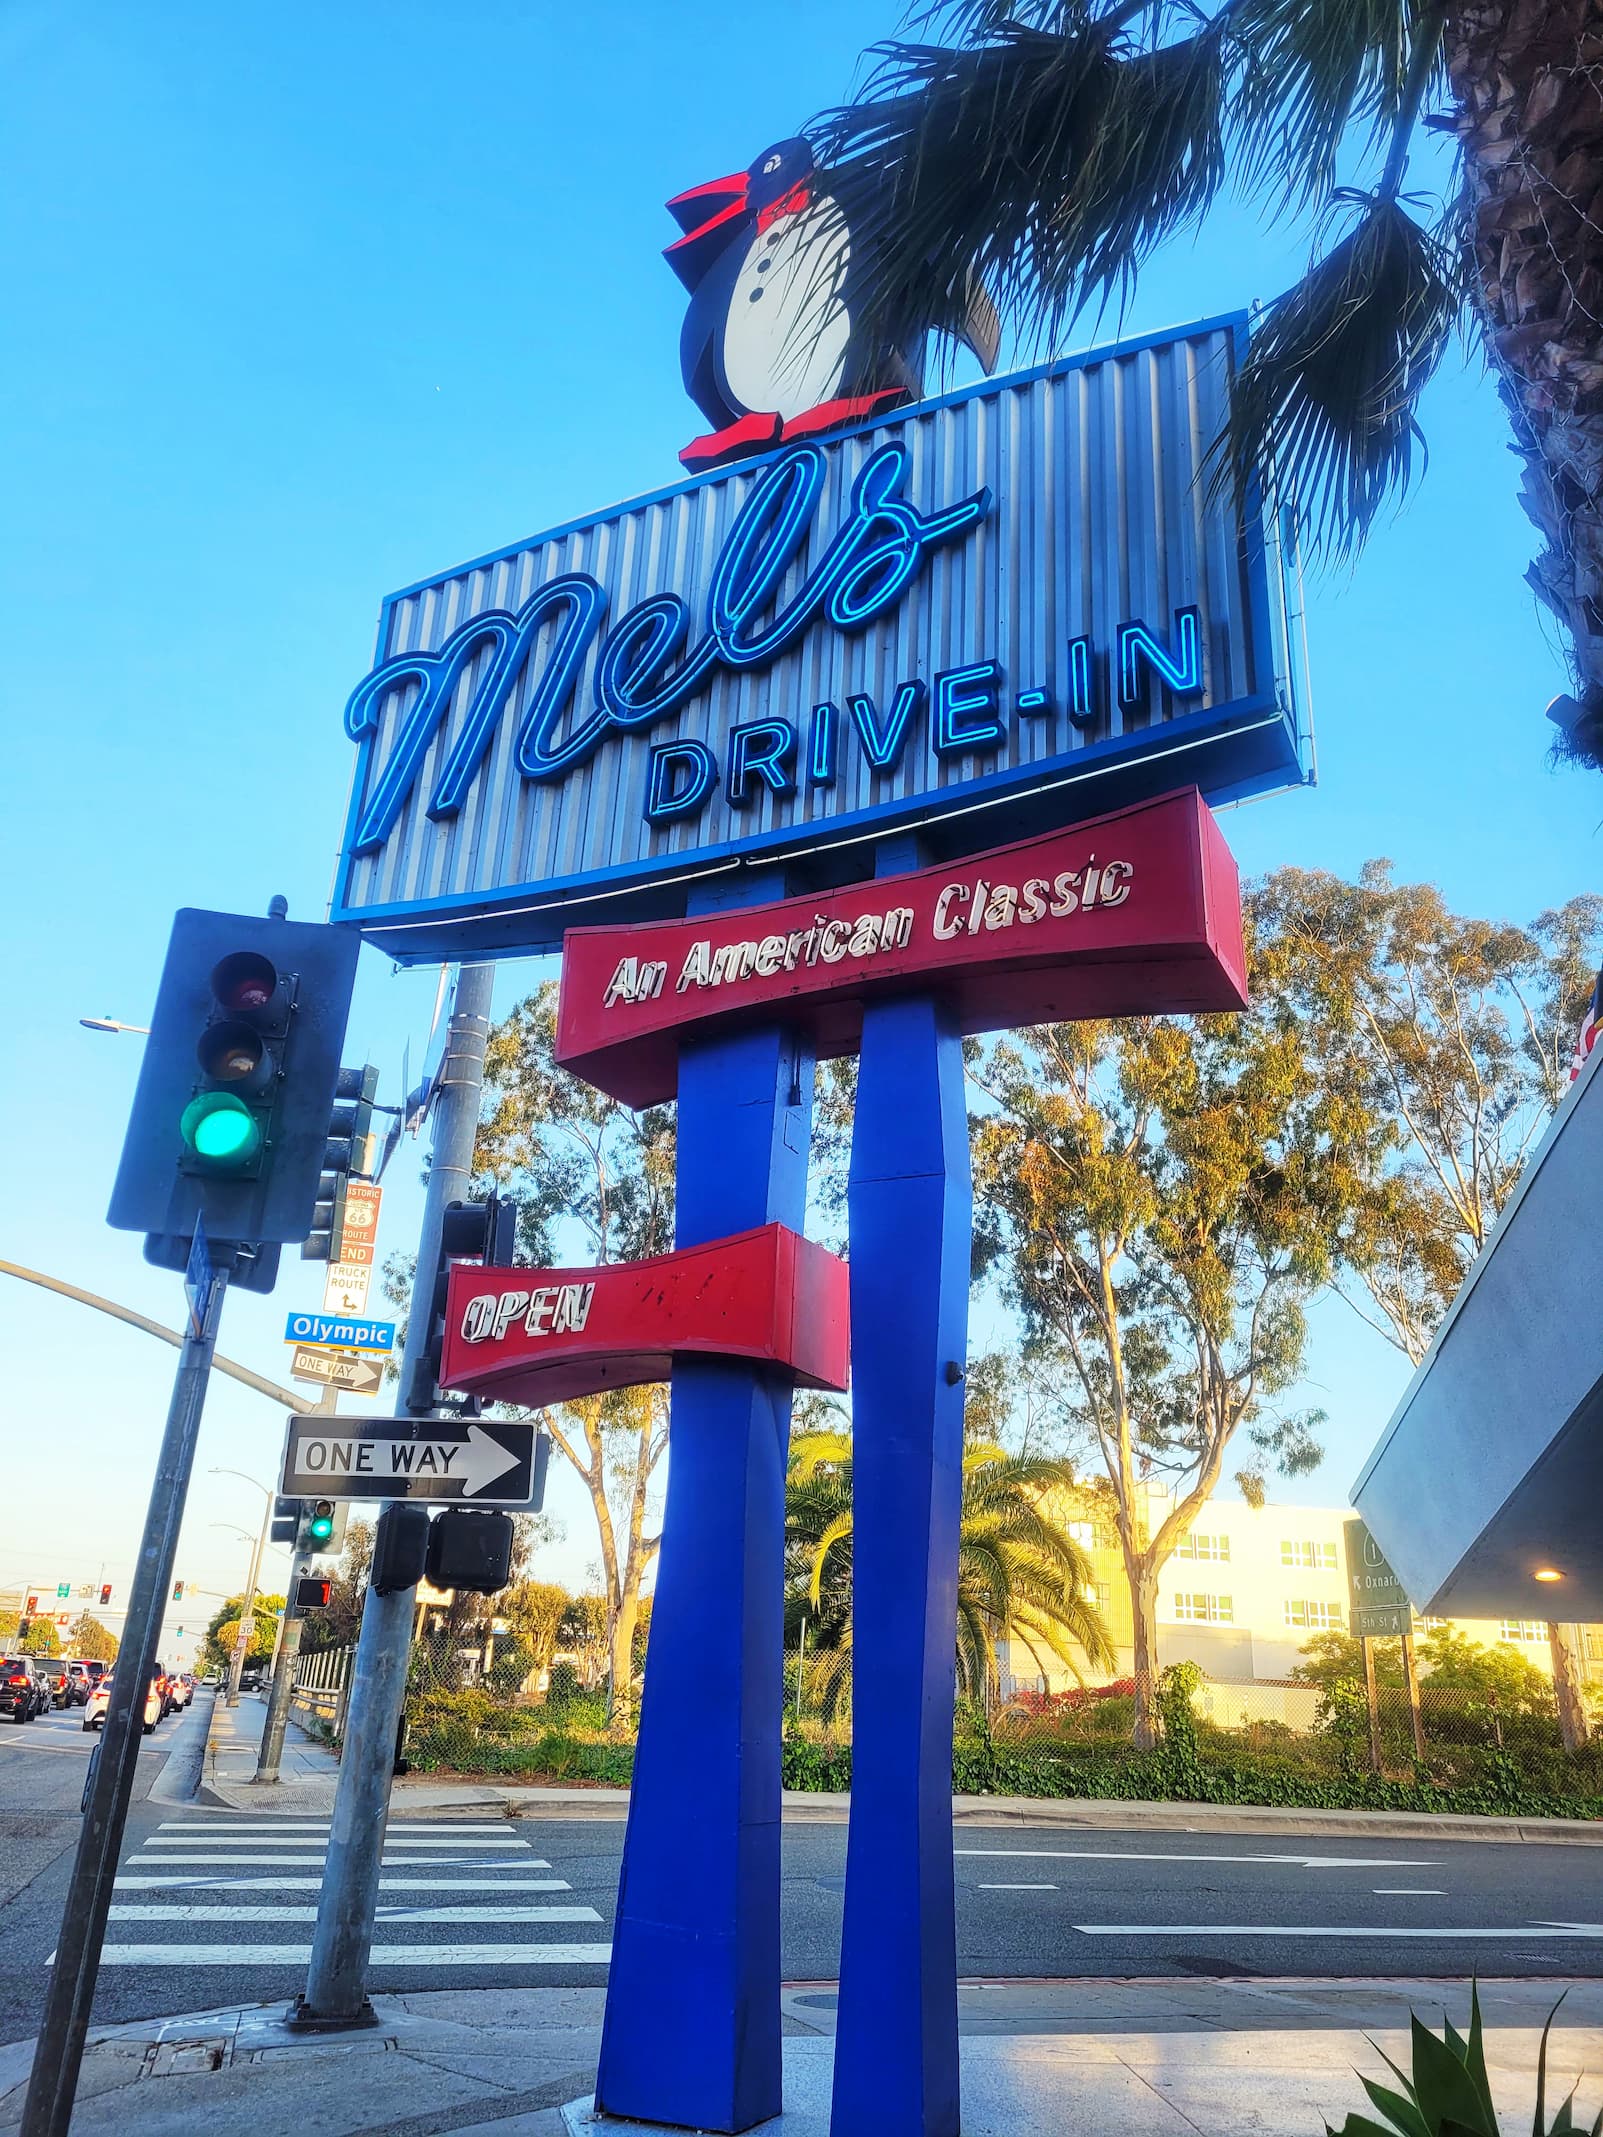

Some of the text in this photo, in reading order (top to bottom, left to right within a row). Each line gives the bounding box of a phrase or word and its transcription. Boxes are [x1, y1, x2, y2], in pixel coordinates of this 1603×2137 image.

[343, 441, 991, 857] Mels
[643, 605, 1202, 828] DRIVE-IN
[603, 854, 1135, 1008] An American Classic
[347, 1187, 380, 1199] ISTORIC
[349, 1212, 366, 1224] 66
[343, 1229, 369, 1240] ROUTE
[341, 1246, 366, 1260] END
[333, 1265, 367, 1278] TRUCK
[330, 1277, 366, 1290] ROUTE
[460, 1282, 596, 1344] OPEN
[293, 1317, 388, 1345] Olympic
[299, 1355, 355, 1377] ONE WAY
[305, 1441, 460, 1474] ONE WAY
[1361, 1616, 1388, 1628] 5th St
[240, 1626, 252, 1635] 30
